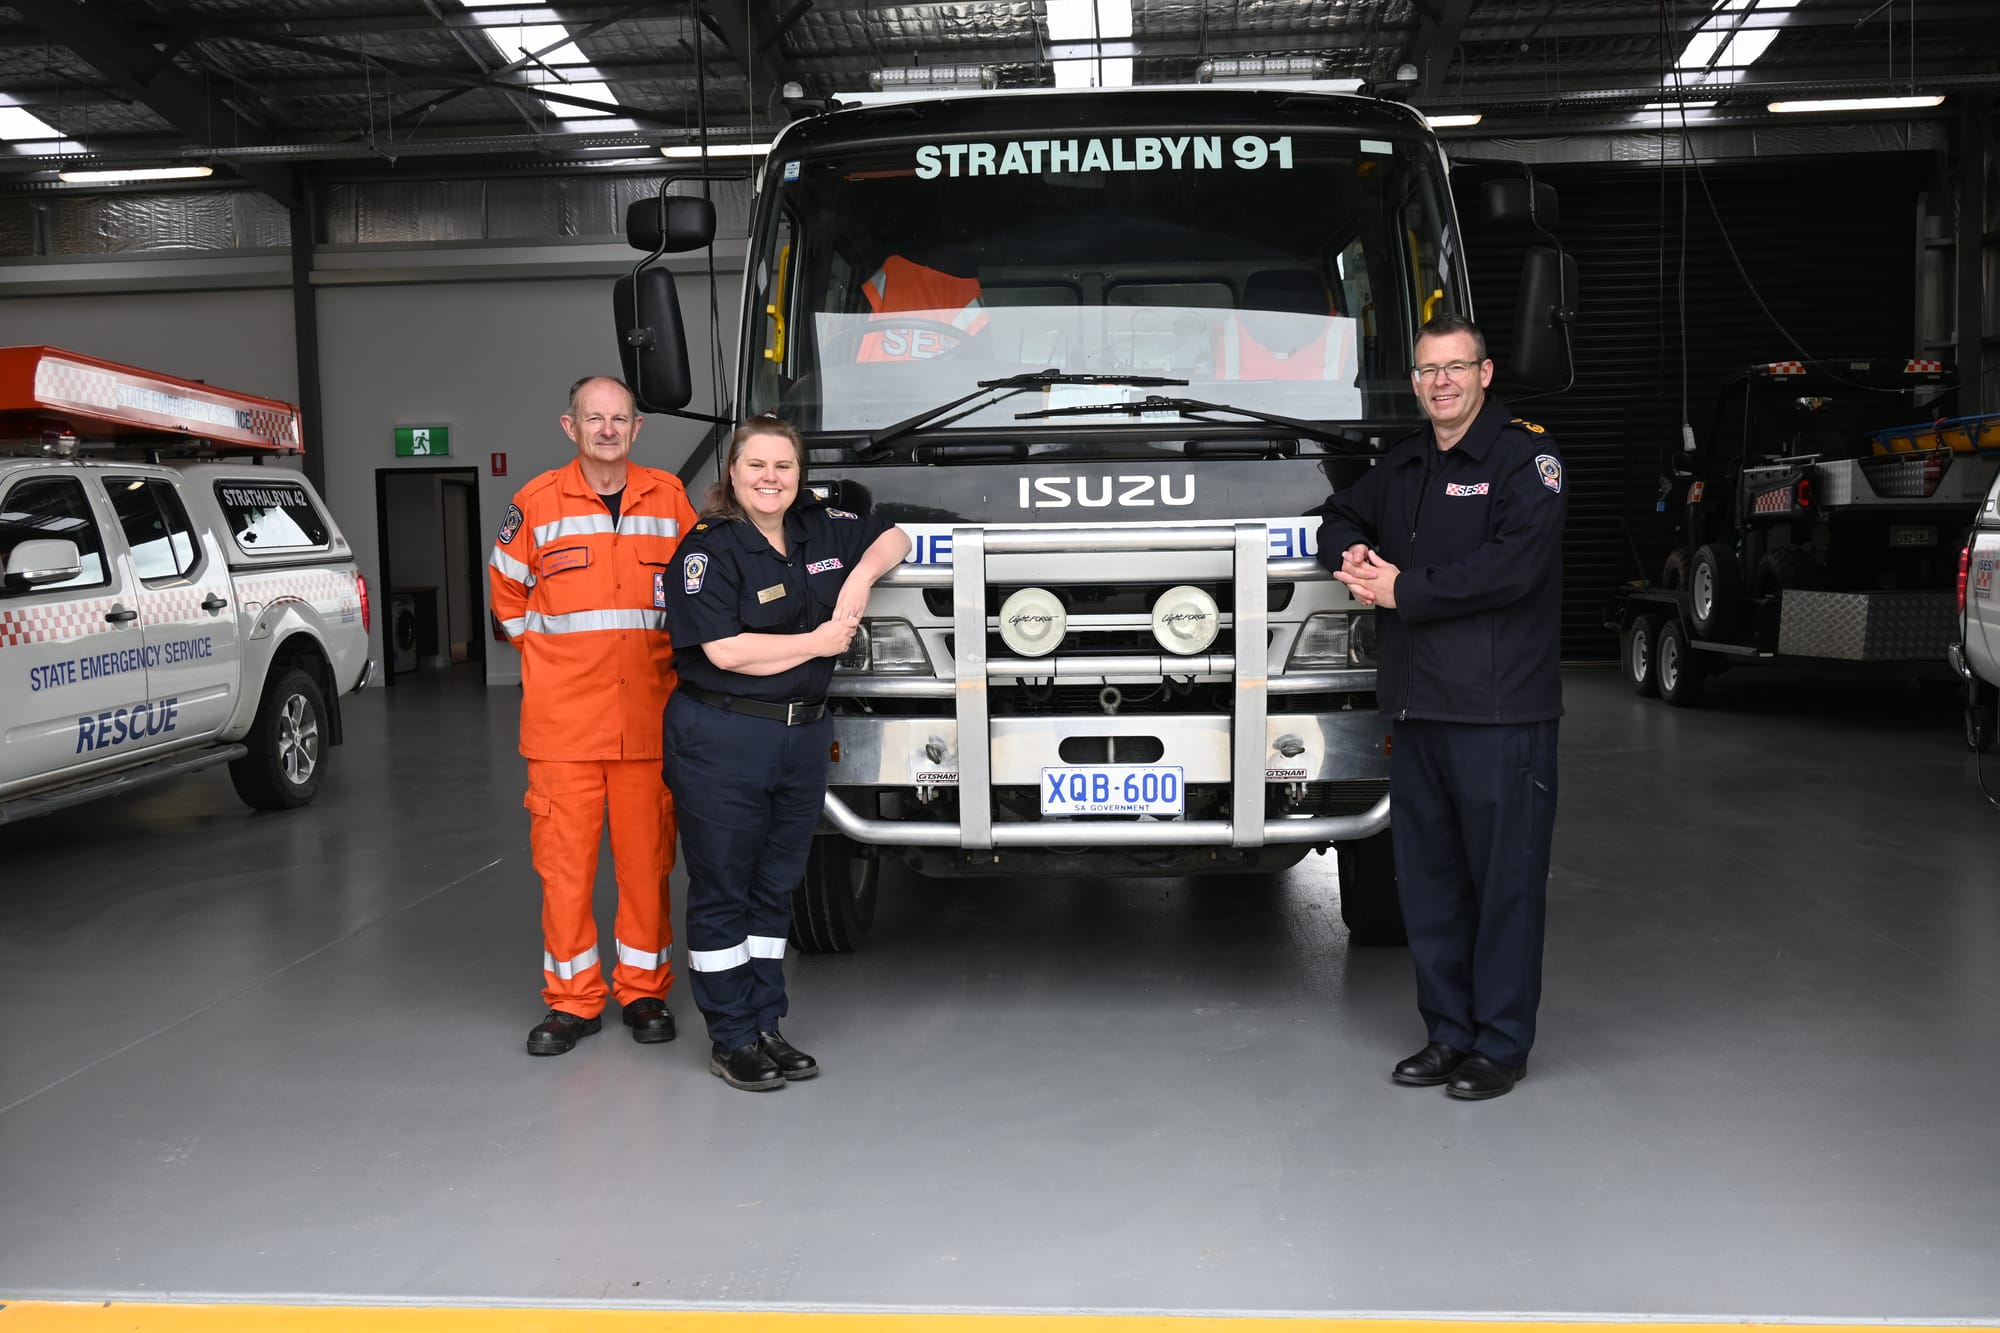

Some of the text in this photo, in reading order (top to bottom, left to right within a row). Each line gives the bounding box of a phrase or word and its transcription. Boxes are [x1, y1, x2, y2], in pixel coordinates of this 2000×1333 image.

[915, 136, 1294, 180] STRATHALBYN 91
[117, 385, 149, 409] STATE
[223, 489, 307, 507] STRATHALBYN 42
[1019, 474, 1196, 508] ISUZU
[1980, 559, 1993, 571] SES
[30, 636, 212, 692] STATE EMERGENCY SERVICE
[75, 697, 178, 754] RESCUE
[1074, 804, 1150, 812] SA GOVERNMENT
